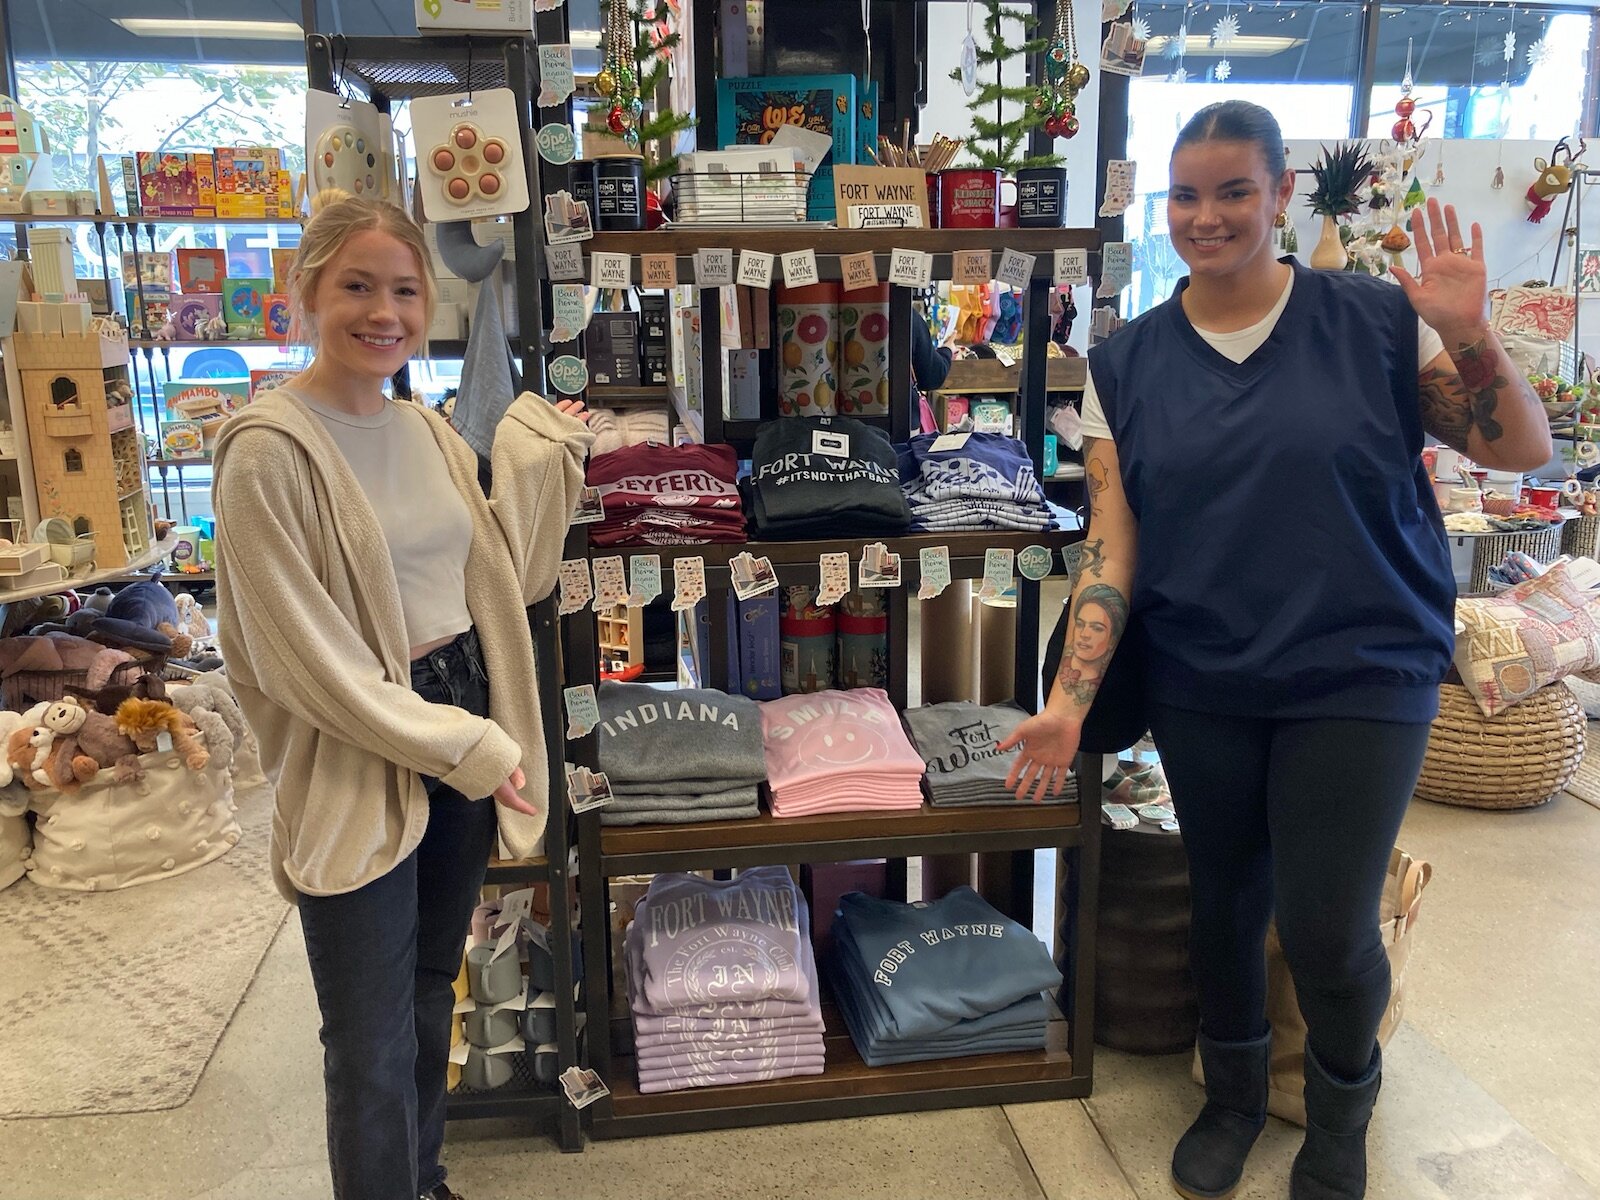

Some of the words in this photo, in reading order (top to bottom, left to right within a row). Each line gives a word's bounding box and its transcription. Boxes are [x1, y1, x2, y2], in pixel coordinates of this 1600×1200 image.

[728, 81, 763, 90] PUZZLE
[450, 109, 478, 118] mushie
[808, 115, 825, 128] you
[840, 183, 869, 199] FORT
[874, 184, 916, 200] WAYNE
[858, 206, 880, 219] FORT
[884, 205, 914, 218] WAYNE
[555, 250, 572, 259] FORT
[706, 254, 723, 264] FORT
[898, 255, 916, 265] FORT
[967, 256, 983, 265] FORT
[552, 259, 578, 270] WAYNE
[604, 259, 621, 269] FORT
[649, 260, 667, 270] FORT
[747, 257, 765, 268] FORT
[790, 256, 808, 267] FORT
[849, 259, 866, 271] FORT
[1008, 256, 1025, 268] FORT
[1062, 257, 1079, 266] FORT
[601, 268, 625, 279] WAYNE
[647, 270, 672, 279] WAYNE
[704, 264, 728, 274] WAYNE
[743, 266, 767, 279] WAYNE
[788, 266, 813, 278] WAYNE
[848, 268, 872, 280] WAYNE
[894, 265, 918, 276] WAYNE
[964, 265, 987, 275] WAYNE
[1003, 265, 1027, 279] WAYNE
[1060, 266, 1083, 275] WAYNE
[550, 359, 586, 381] Ope!
[759, 453, 814, 479] FORT
[616, 473, 725, 493] SEYFERT'S
[775, 470, 890, 486] #ITSNOTTHATBAD
[602, 701, 740, 737] INDIANA
[768, 701, 886, 740] SMILE
[948, 720, 1001, 745] Fort
[650, 892, 708, 948] FORT
[714, 887, 800, 936] WAYNE
[667, 956, 685, 987] The
[680, 934, 710, 958] Fort
[713, 925, 768, 947] Wayne
[769, 946, 795, 973] Club
[874, 940, 915, 987] FORT
[920, 924, 1004, 946] WAYNE
